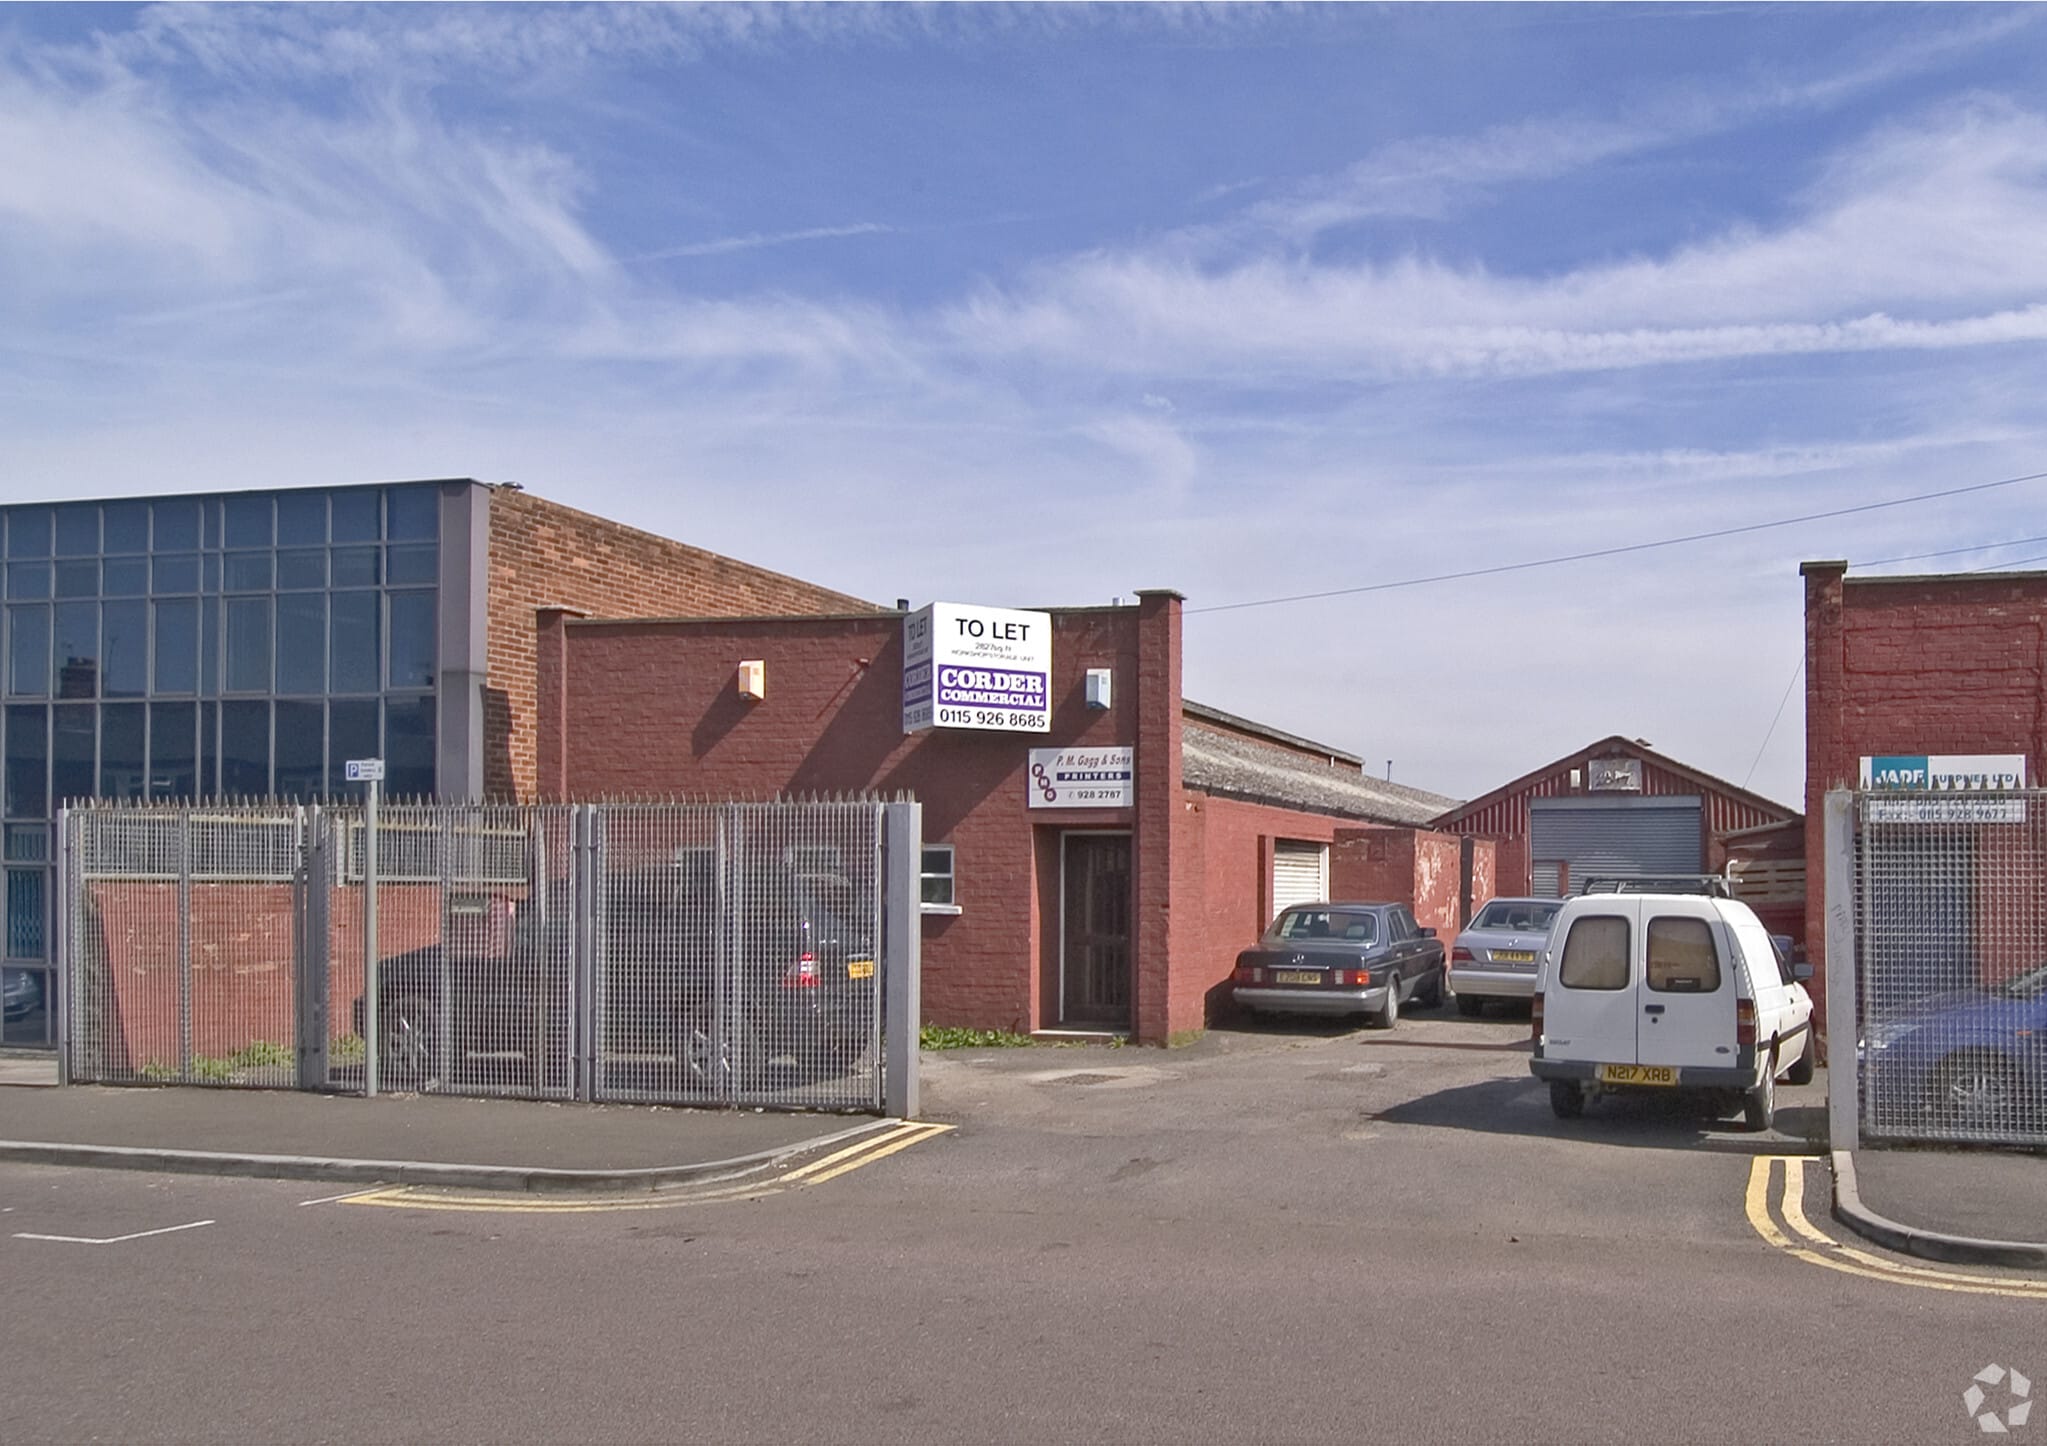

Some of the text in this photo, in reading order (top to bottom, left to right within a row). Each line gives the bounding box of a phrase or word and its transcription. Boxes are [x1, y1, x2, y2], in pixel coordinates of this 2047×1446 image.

[955, 618, 1030, 641] TO LET
[940, 668, 1044, 694] CORDER
[940, 688, 1044, 707] COMMERCIAL
[940, 708, 971, 724] 0115
[976, 711, 1004, 726] 926
[1009, 713, 1045, 728] 8685
[1607, 1065, 1639, 1080] N217
